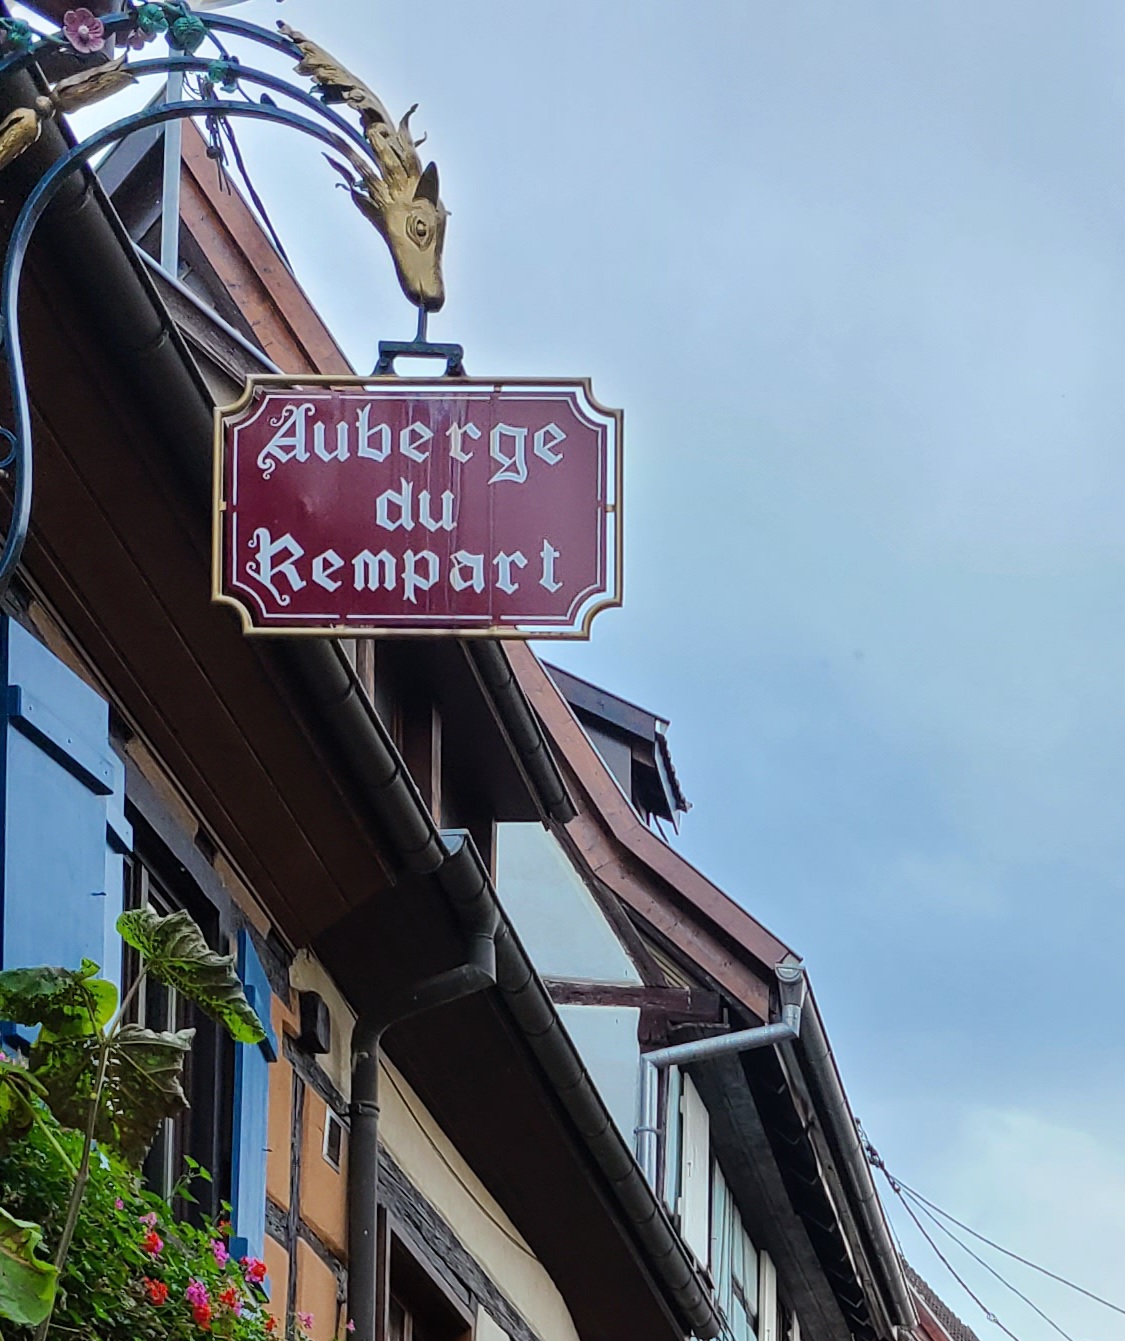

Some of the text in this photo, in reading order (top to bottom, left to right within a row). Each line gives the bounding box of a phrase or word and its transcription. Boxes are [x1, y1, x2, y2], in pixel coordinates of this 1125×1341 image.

[257, 402, 567, 485] Auberge
[375, 477, 457, 532] du
[246, 527, 565, 607] Rempart
